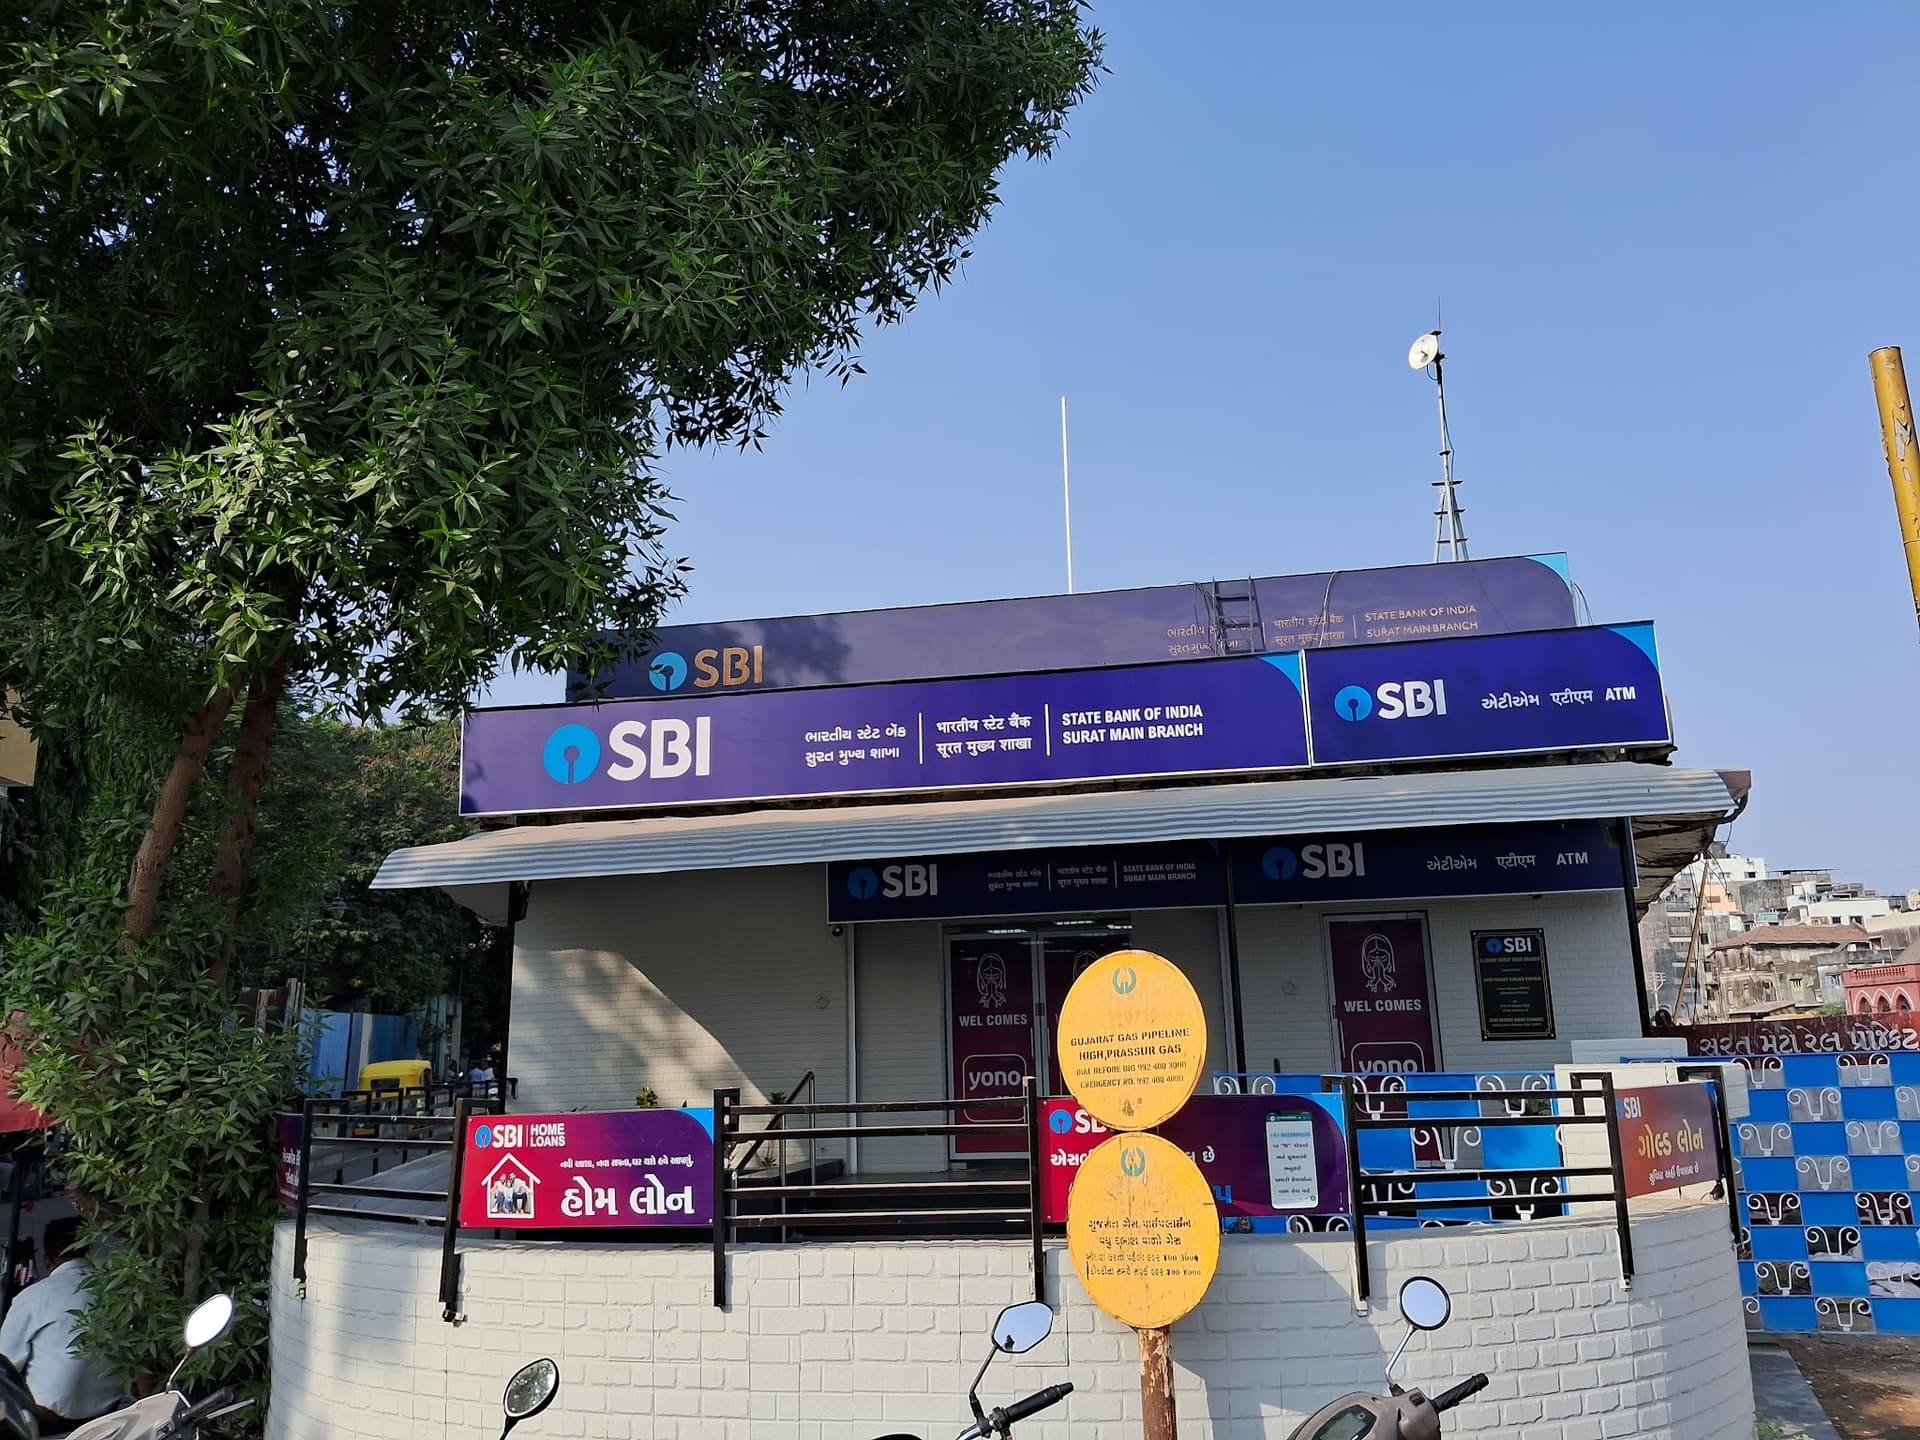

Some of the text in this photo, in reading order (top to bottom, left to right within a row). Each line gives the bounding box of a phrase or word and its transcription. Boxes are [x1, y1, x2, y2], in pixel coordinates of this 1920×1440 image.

[1365, 604, 1477, 622] STATE BANK OF INDIA
[1167, 624, 1205, 638] ભારતીય
[1367, 621, 1479, 638] SURAT MAIN BRANCH
[694, 645, 763, 688] SBI
[1376, 679, 1447, 719] SBI
[1481, 690, 1540, 710] એટીએમ
[1550, 688, 1593, 706] एटीएम
[1605, 686, 1636, 701] ATM
[935, 711, 1032, 734] भारतीय स्टेट बैंक
[1062, 704, 1203, 726] STATE BANK OF INDIA
[805, 726, 852, 743] ભારતીય
[856, 724, 881, 740] સ્ટેટ
[1063, 723, 1203, 744] SURAT MAIN BRANCH
[607, 716, 710, 782] SBI
[805, 747, 900, 767] સુરત મુખ્ય શાખા
[936, 737, 1032, 758] सूरत मुख्य शाखा
[1123, 864, 1144, 873] STATE
[1145, 864, 1165, 872] BANK
[1301, 843, 1365, 879] SBI
[1426, 855, 1478, 871] એટીએમ
[1495, 854, 1536, 868] एटीएम
[1556, 852, 1588, 866] ATM
[882, 864, 938, 898] SBI
[1123, 874, 1147, 882] SURAT
[1167, 872, 1196, 880] BRANCH
[1503, 936, 1532, 953] SBI
[1344, 999, 1422, 1012] WEL COMES
[959, 1013, 1027, 1027] WEL COMES
[1071, 1027, 1190, 1047] GUJARAT GAS PIPELINE
[1159, 1043, 1182, 1055] GAS
[1076, 1068, 1091, 1076] DIAL
[1093, 1064, 1121, 1074] BEFORE
[1359, 1060, 1418, 1080] yono
[968, 1070, 1021, 1091] yono
[1080, 1079, 1121, 1089] EMERGENCY
[1623, 1096, 1641, 1119] SBI
[492, 1124, 523, 1149] SBI
[530, 1123, 565, 1136] HOME
[1676, 1118, 1704, 1153] લોન
[530, 1135, 566, 1148] LOANS
[560, 1174, 695, 1217] હોમ લોન
